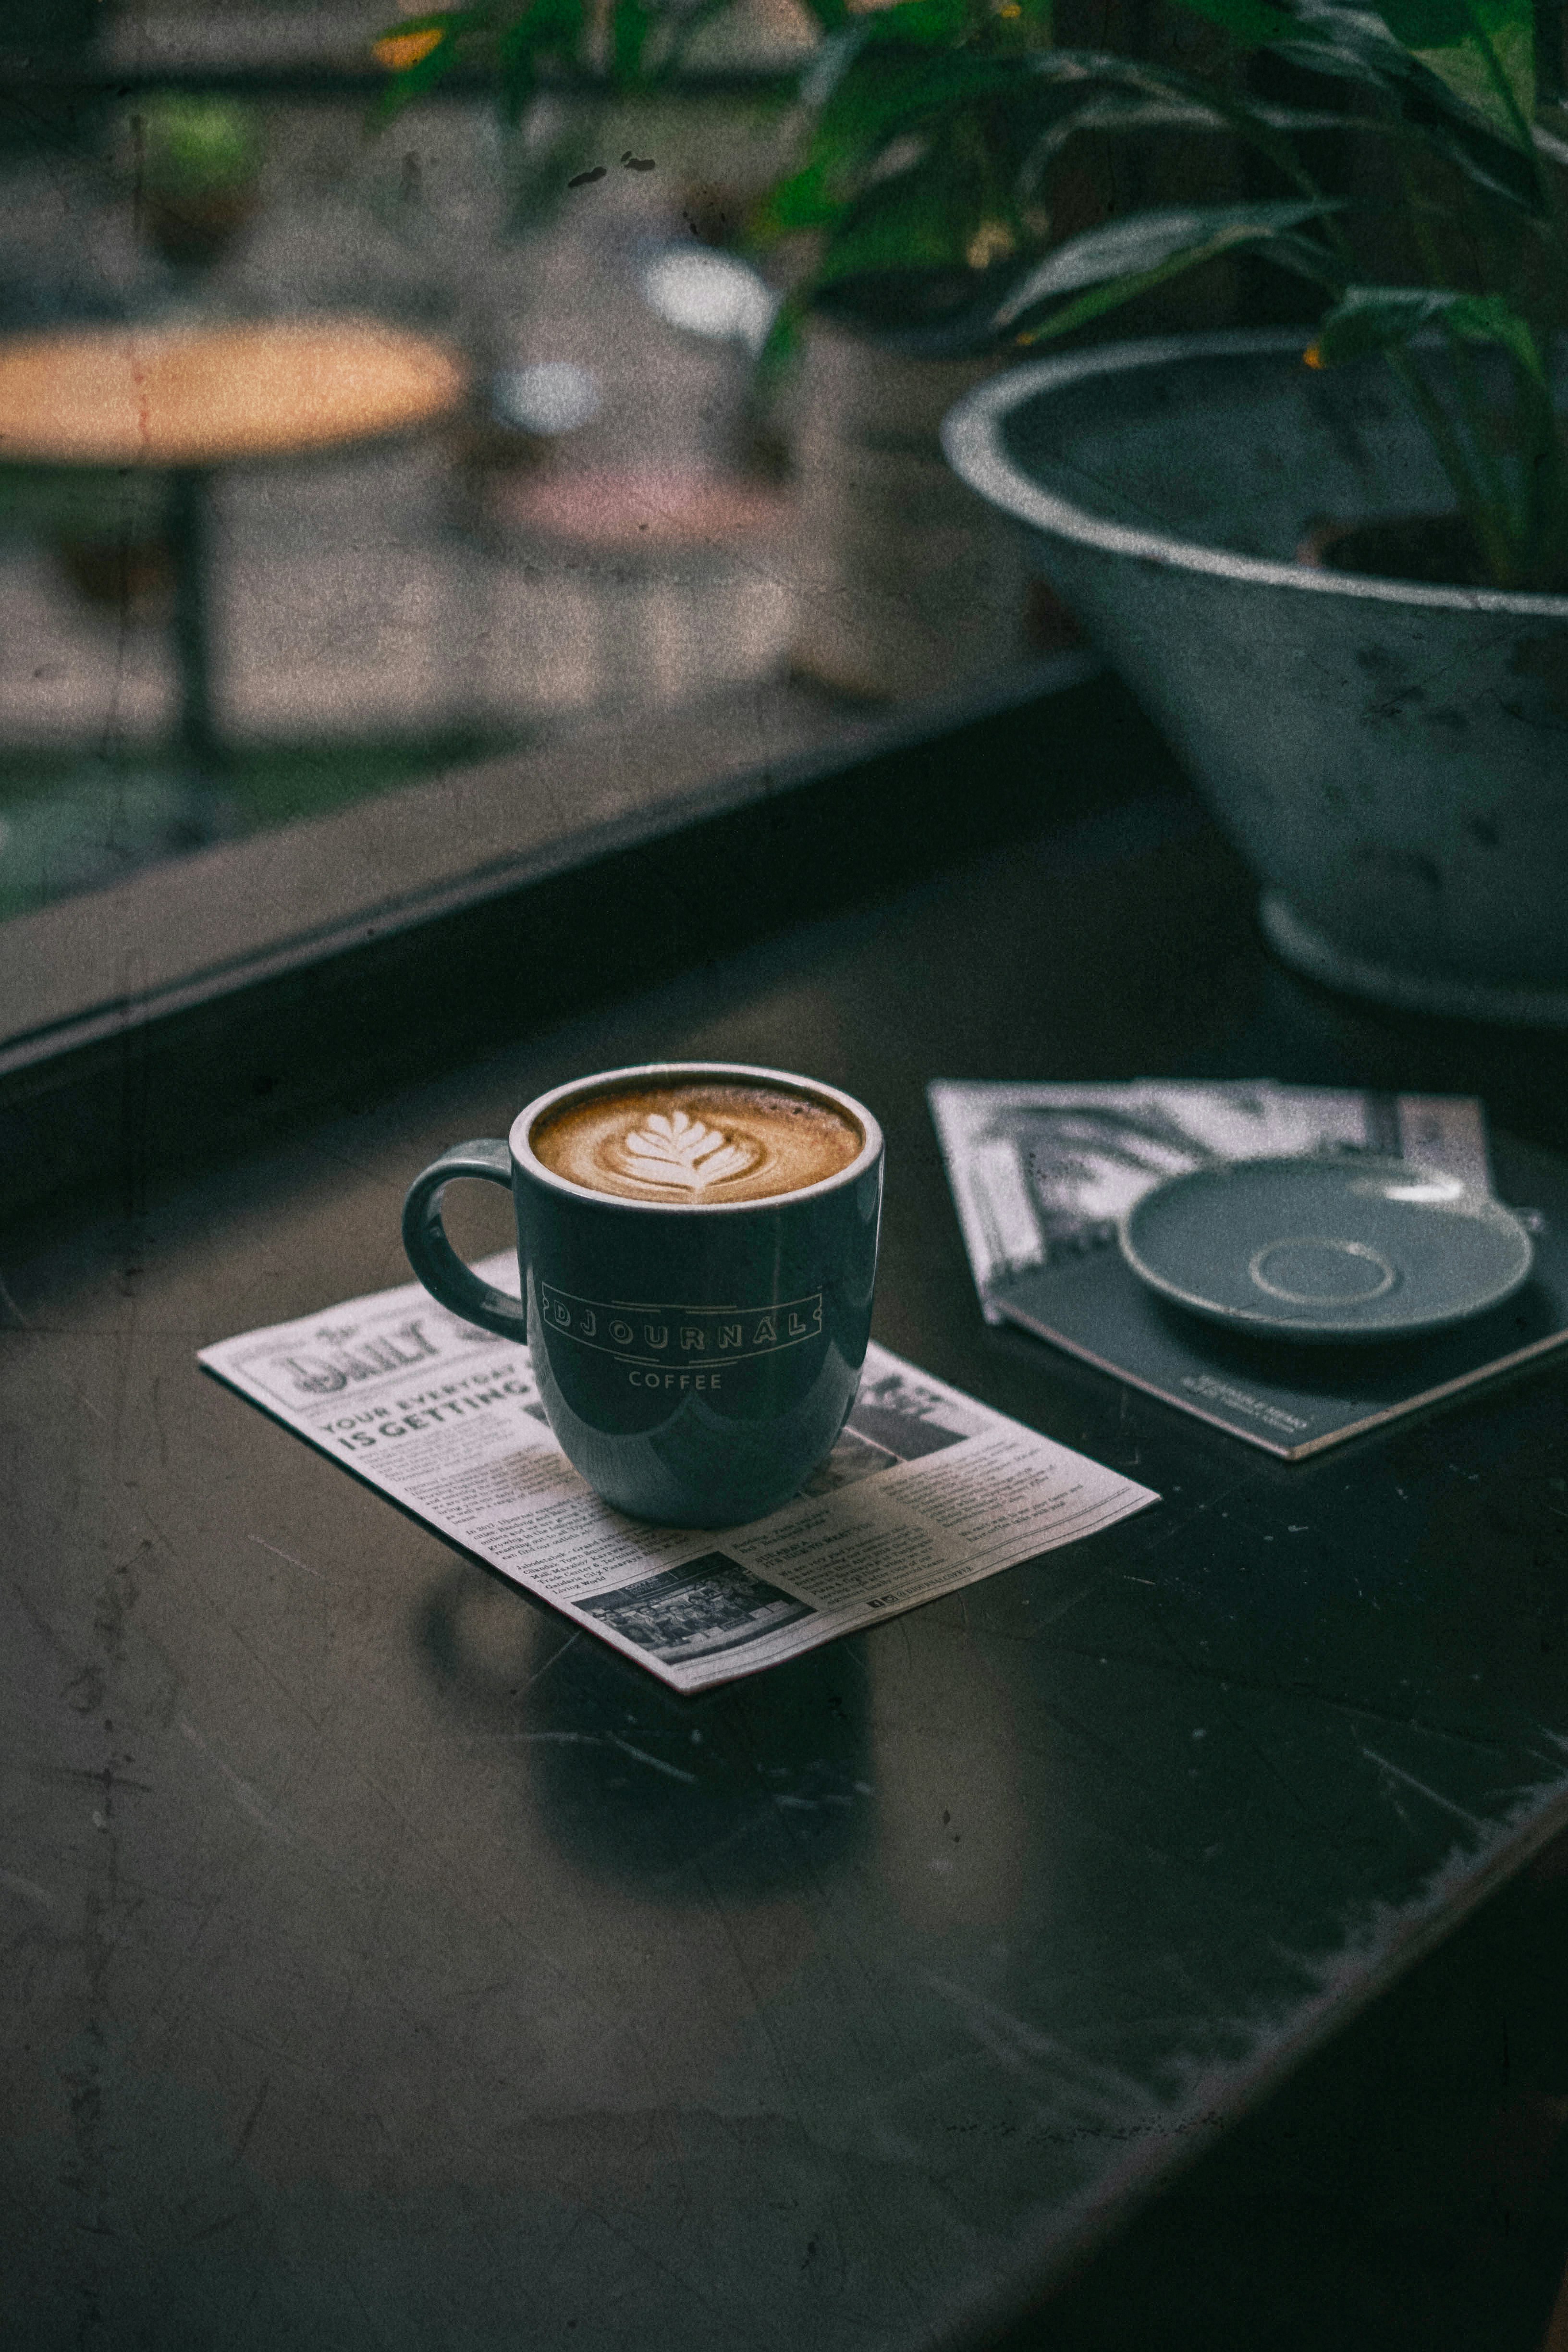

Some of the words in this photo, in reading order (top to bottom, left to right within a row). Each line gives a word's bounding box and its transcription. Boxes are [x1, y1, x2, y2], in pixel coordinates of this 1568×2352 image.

[554, 1299, 806, 1350] DJOURNAL
[629, 1371, 721, 1390] COFFEE
[324, 1406, 390, 1435] YOUR
[395, 1363, 516, 1411] EVERYDAY
[338, 1431, 377, 1451] IS
[378, 1380, 529, 1437] GETTING
[497, 1520, 534, 1532] Bandung
[498, 1512, 534, 1525] Djournal
[480, 1534, 508, 1545] outlets
[488, 1538, 523, 1551] growing
[549, 1516, 587, 1531] following
[552, 1534, 579, 1544] outlets
[824, 1530, 850, 1543] MEET
[495, 1543, 531, 1555] reaching
[516, 1553, 566, 1570] Jabodetabek
[572, 1541, 600, 1552] Grand
[523, 1563, 558, 1574] Cilandak
[560, 1555, 584, 1563] Town
[583, 1544, 615, 1556] Square,
[537, 1576, 563, 1584] Trade
[564, 1566, 592, 1577] Center
[601, 1549, 638, 1564] Terminal
[545, 1577, 583, 1589] Gandaria
[602, 1556, 642, 1572] Pasaraya
[551, 1584, 581, 1594] Living
[581, 1576, 606, 1585] World
